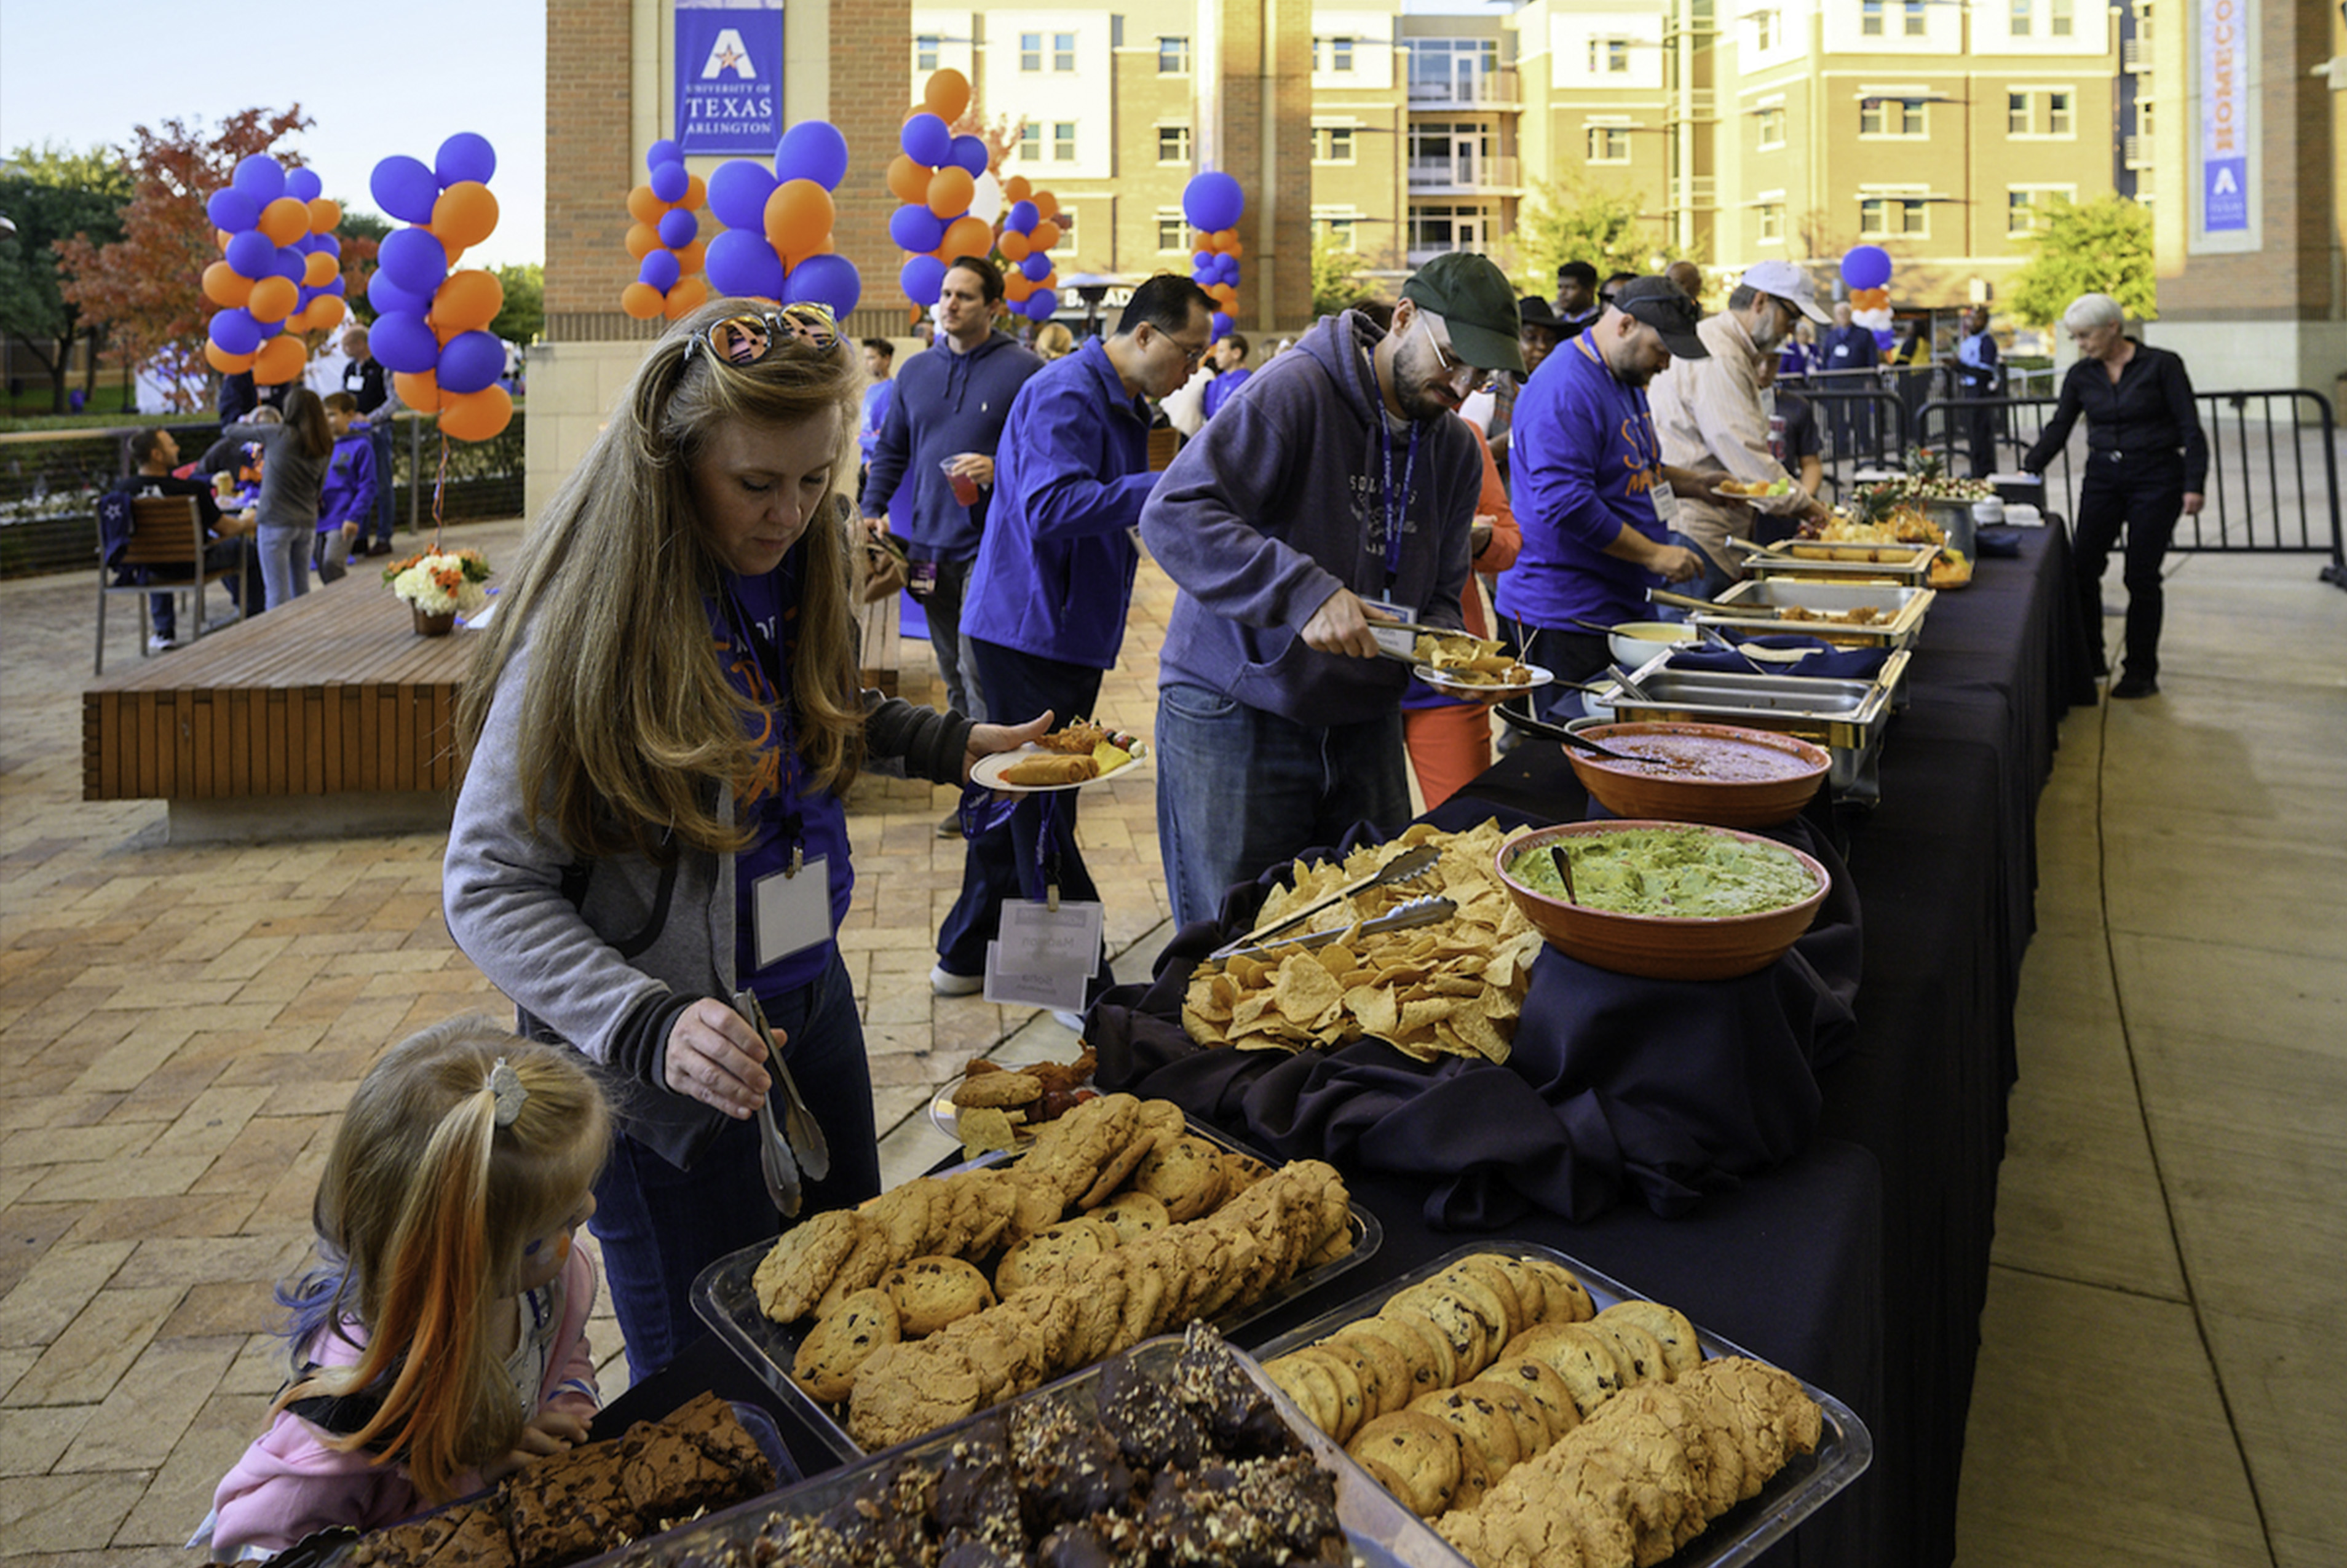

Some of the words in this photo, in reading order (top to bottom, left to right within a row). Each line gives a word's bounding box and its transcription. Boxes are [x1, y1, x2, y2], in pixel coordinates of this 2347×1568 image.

[700, 28, 757, 79] A
[685, 97, 773, 118] TEXAS
[686, 122, 771, 134] ARLINGTON
